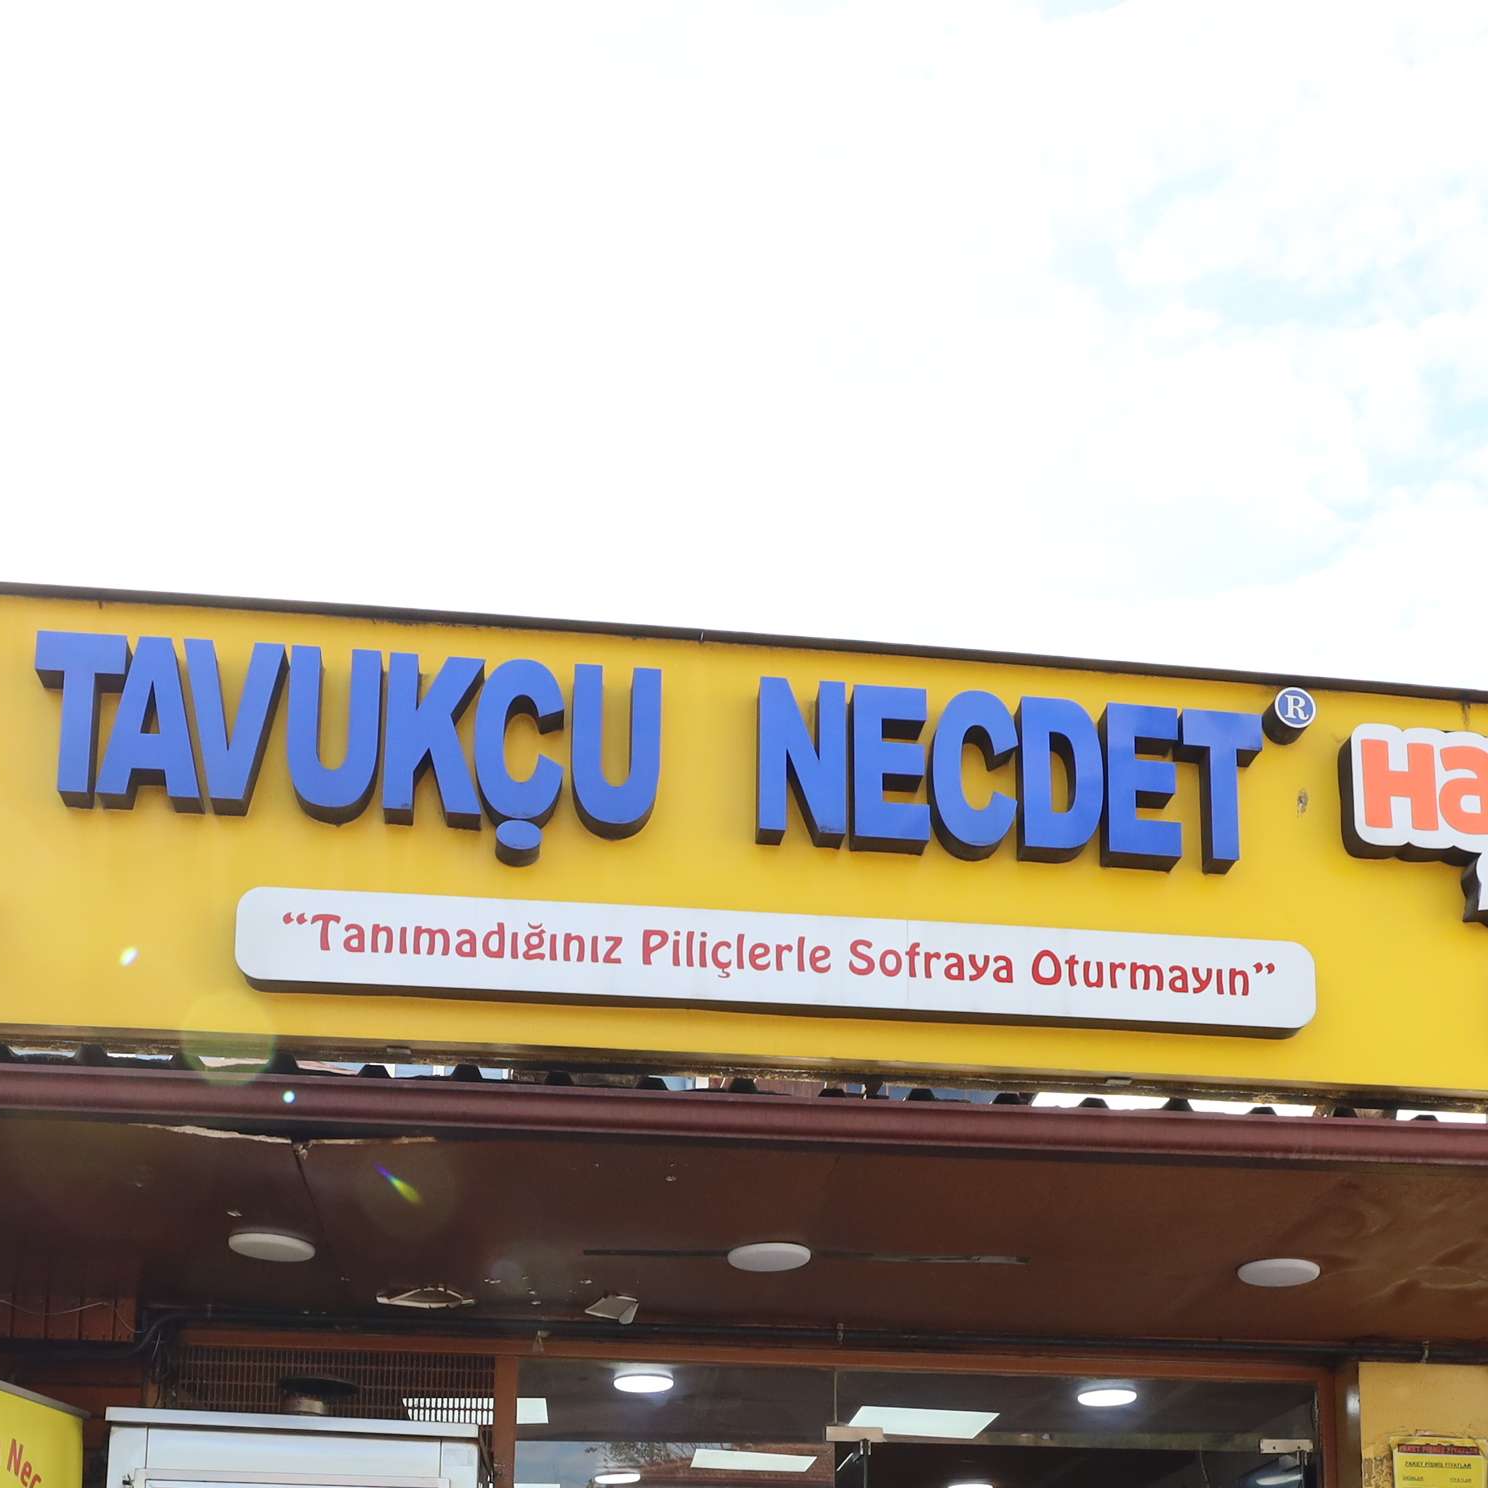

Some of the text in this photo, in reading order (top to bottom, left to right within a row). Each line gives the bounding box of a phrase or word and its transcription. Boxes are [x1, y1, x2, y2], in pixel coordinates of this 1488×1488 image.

[35, 630, 662, 860] TAVUKÇU
[756, 676, 1262, 872] NECDET
[641, 929, 831, 979] Piliçlerle
[848, 938, 1014, 984] Sofraya
